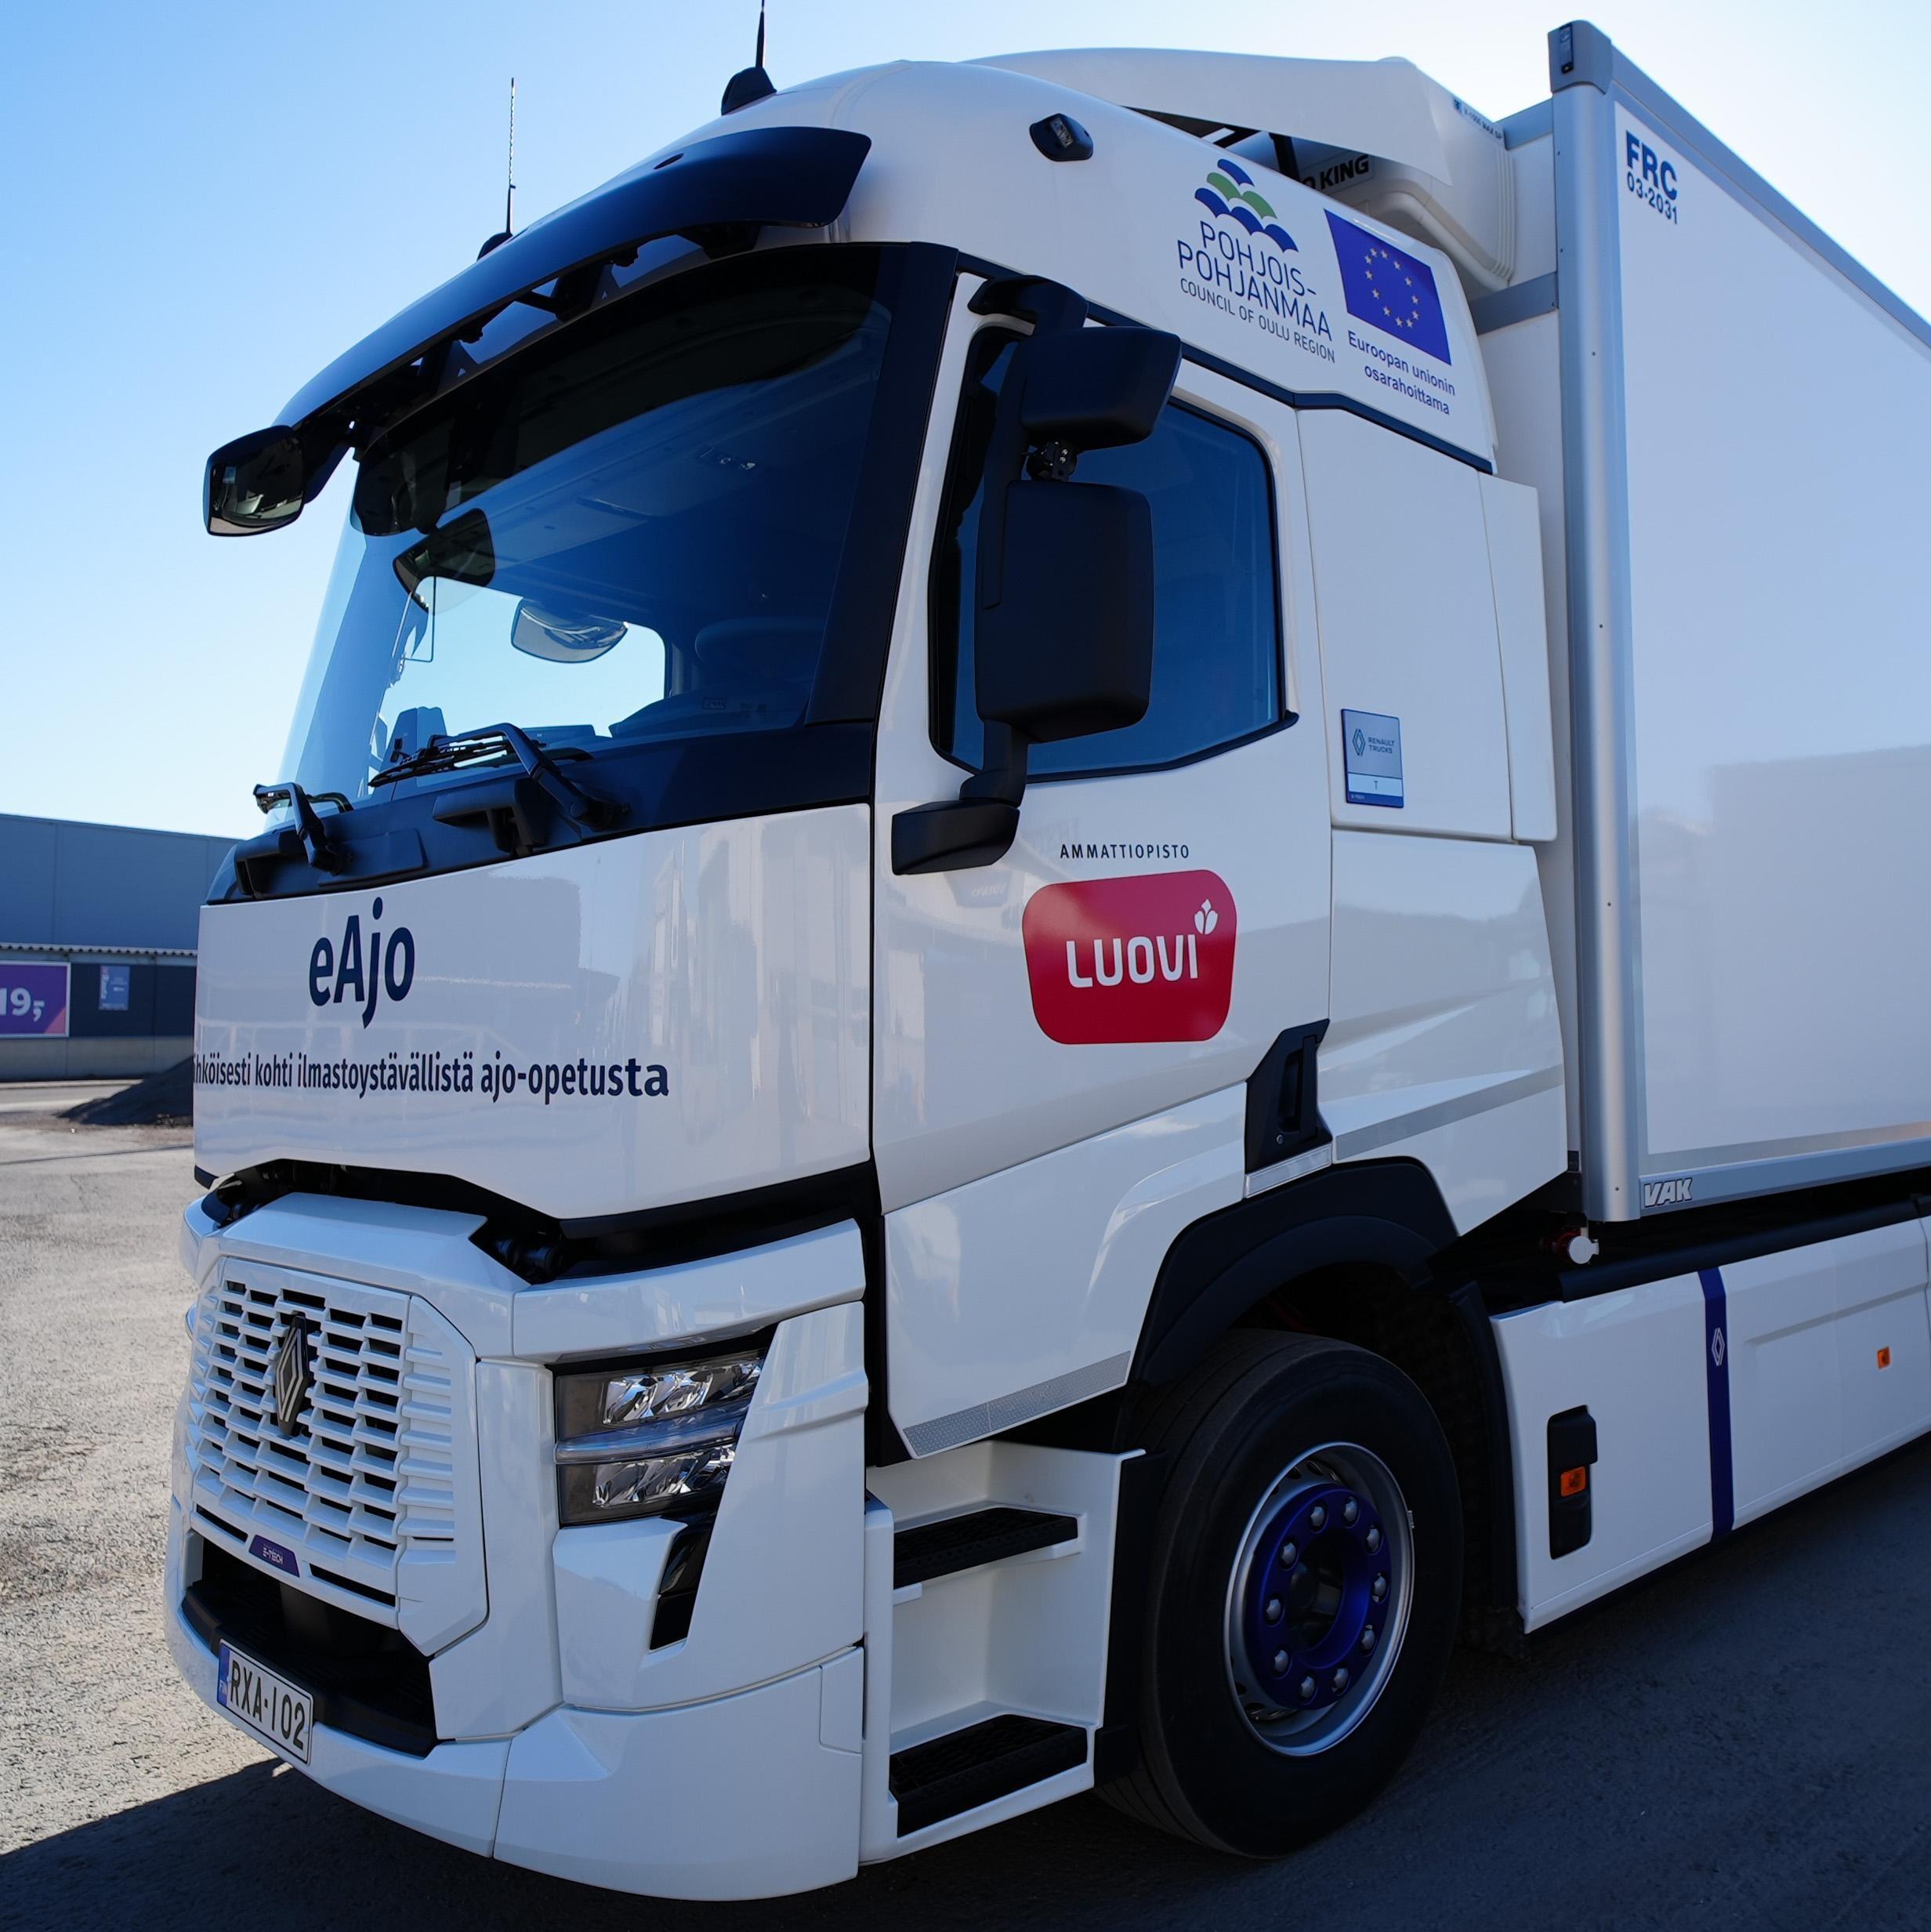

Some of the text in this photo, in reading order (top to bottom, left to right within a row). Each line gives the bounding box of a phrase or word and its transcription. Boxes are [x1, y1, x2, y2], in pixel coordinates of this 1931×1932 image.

[1320, 154, 1369, 190] KING
[1626, 130, 1677, 201] FRC
[1627, 171, 1678, 225] 03-2031
[1200, 220, 1317, 296] POHJOIS-
[1177, 240, 1332, 342] POHJANMAA
[1180, 277, 1335, 364] COUNCIL OF OULU REGION
[1348, 330, 1455, 396] Euroopan unionin
[1364, 365, 1450, 415] osarahoittama
[1368, 737, 1395, 746] RENAULT
[1368, 745, 1393, 754] TRUCKS
[1060, 844, 1189, 859] AMMATTIOPISTO
[310, 897, 415, 1029] eAjo
[194, 1050, 668, 1105] hköisesti kohti ilmastoystävällistä ajo-opetusta
[1644, 1177, 1693, 1208] VAK
[230, 1659, 305, 1750] RXA-102
